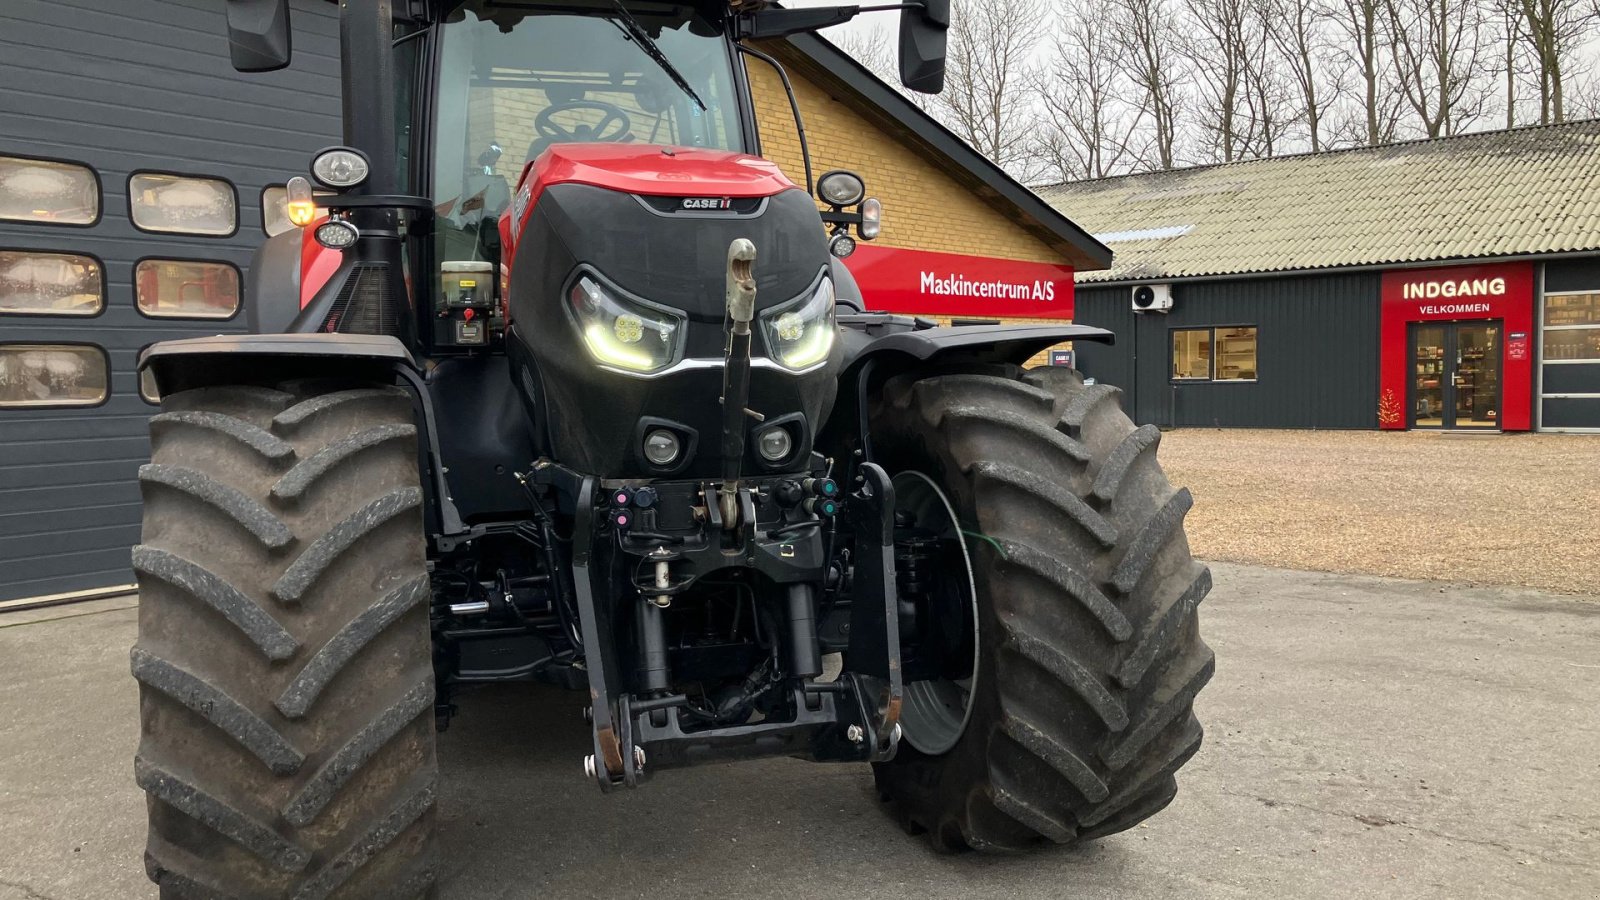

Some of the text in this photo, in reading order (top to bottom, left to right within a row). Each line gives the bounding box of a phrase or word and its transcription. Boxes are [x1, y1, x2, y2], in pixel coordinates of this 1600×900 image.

[683, 199, 718, 209] CASE
[920, 271, 1055, 301] Maskincentrum A/S
[1403, 278, 1505, 299] INDGANG
[1419, 303, 1490, 315] VELKOMMEN
